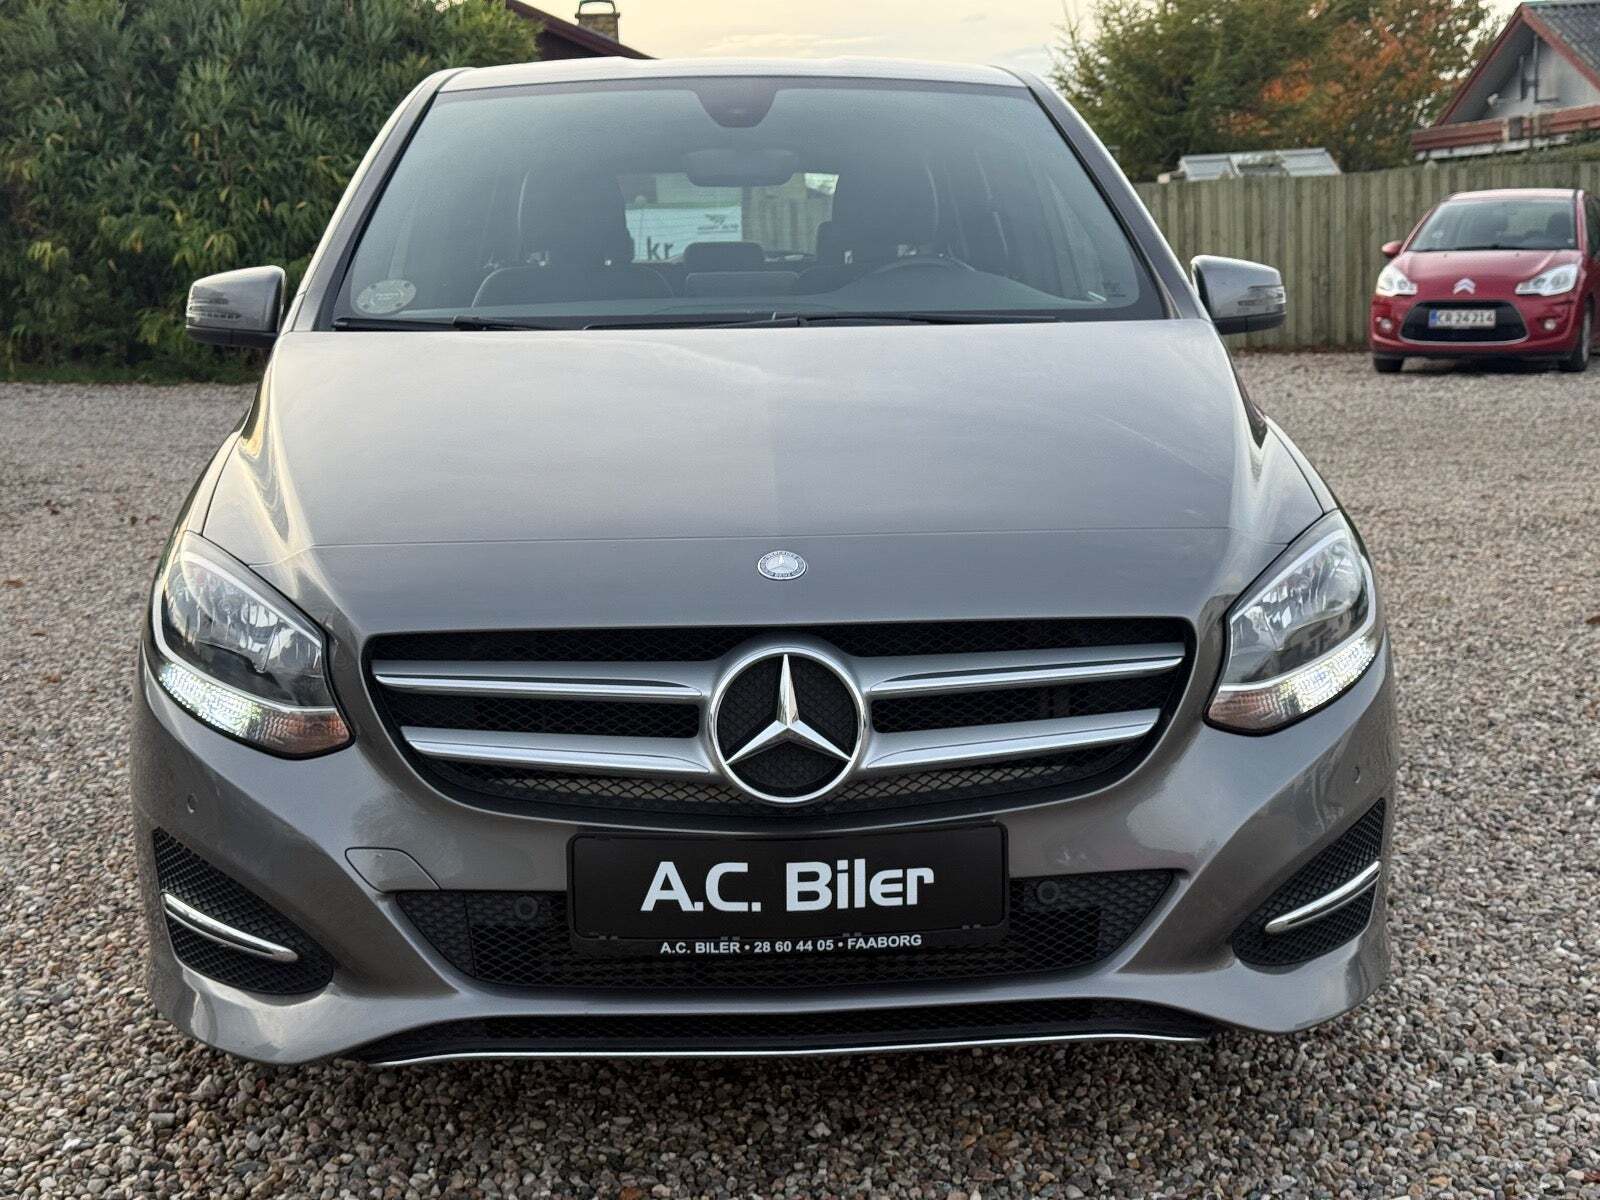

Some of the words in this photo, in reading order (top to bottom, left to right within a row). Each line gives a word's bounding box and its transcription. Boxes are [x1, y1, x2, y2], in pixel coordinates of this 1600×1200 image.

[640, 861, 762, 912] A.C.
[785, 858, 935, 912] Biler
[660, 941, 691, 954] A.C.
[695, 941, 741, 954] BILER
[754, 941, 771, 953] 28
[775, 940, 792, 953] 60
[795, 940, 813, 952] 44
[816, 939, 834, 951] 05
[847, 934, 922, 950] FAABORG
